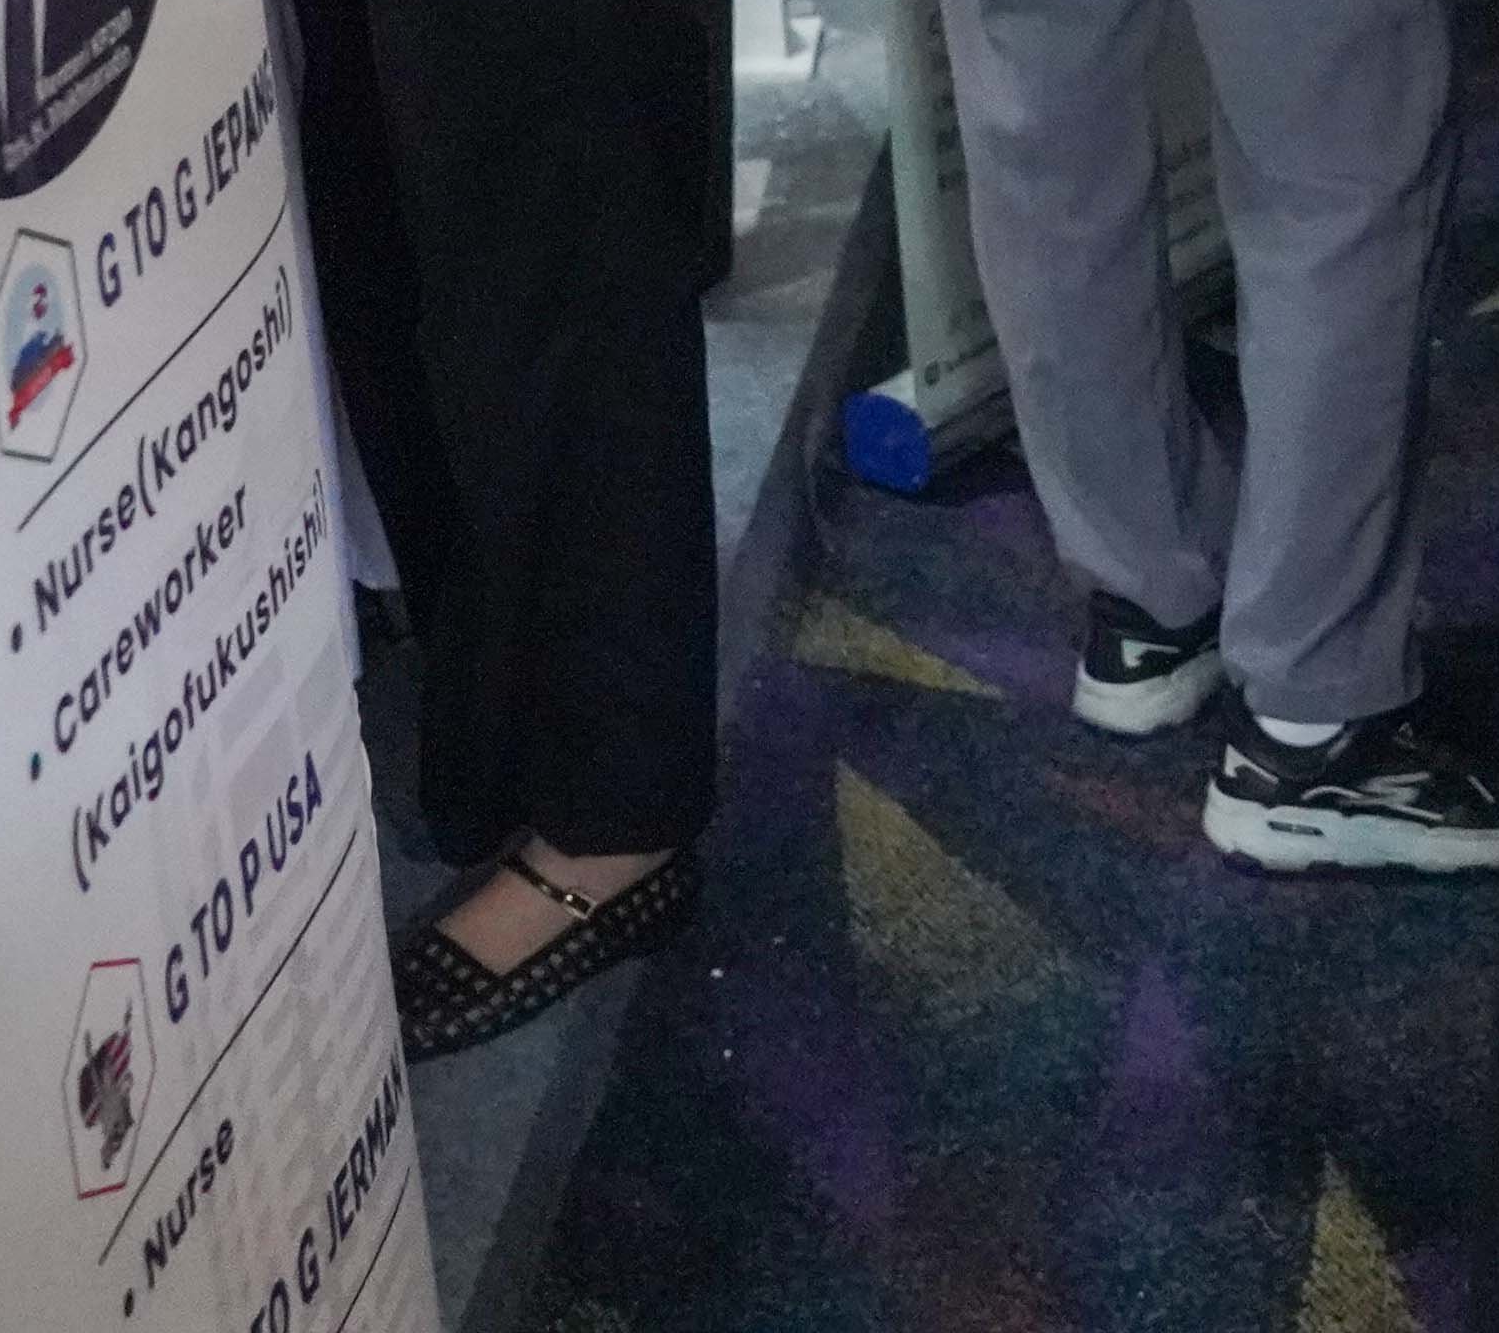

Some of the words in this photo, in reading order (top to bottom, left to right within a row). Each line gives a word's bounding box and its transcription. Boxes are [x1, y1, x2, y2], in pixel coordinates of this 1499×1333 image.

[97, 233, 122, 308] G
[125, 186, 167, 277] TO
[174, 157, 198, 229] G
[72, 469, 329, 893] (Kaigofukushishi)
[165, 944, 189, 1024] G
[190, 877, 235, 979] TO
[238, 837, 261, 918] P
[267, 749, 325, 875] USA
[142, 1118, 235, 1290] Nurse
[297, 1226, 321, 1305] G
